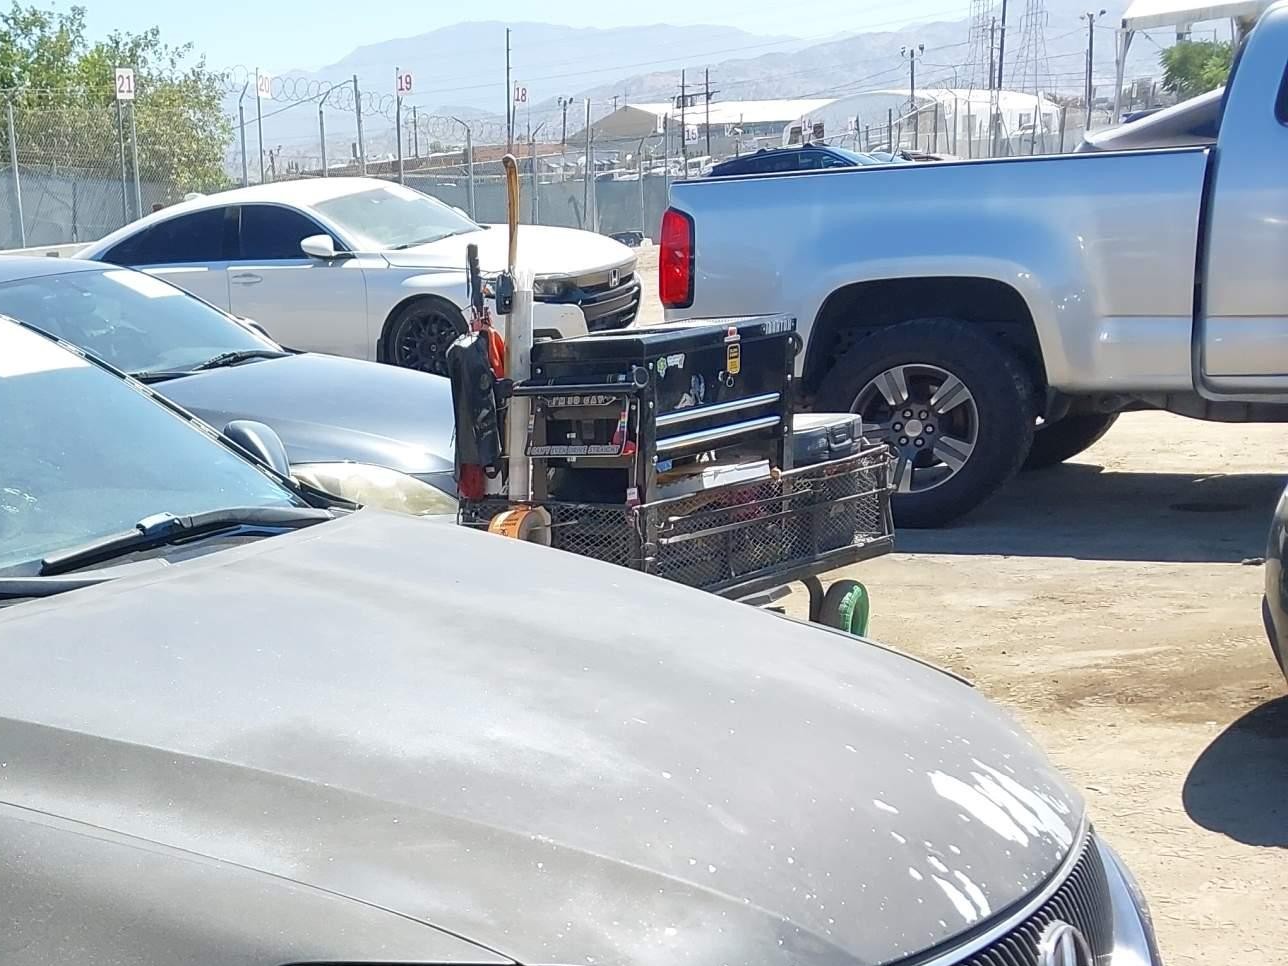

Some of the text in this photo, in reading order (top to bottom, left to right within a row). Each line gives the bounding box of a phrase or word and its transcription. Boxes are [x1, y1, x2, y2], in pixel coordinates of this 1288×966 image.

[117, 74, 133, 93] 21
[259, 74, 270, 93] 20
[398, 74, 412, 91] 19
[515, 87, 527, 102] 18
[685, 129, 697, 141] 15
